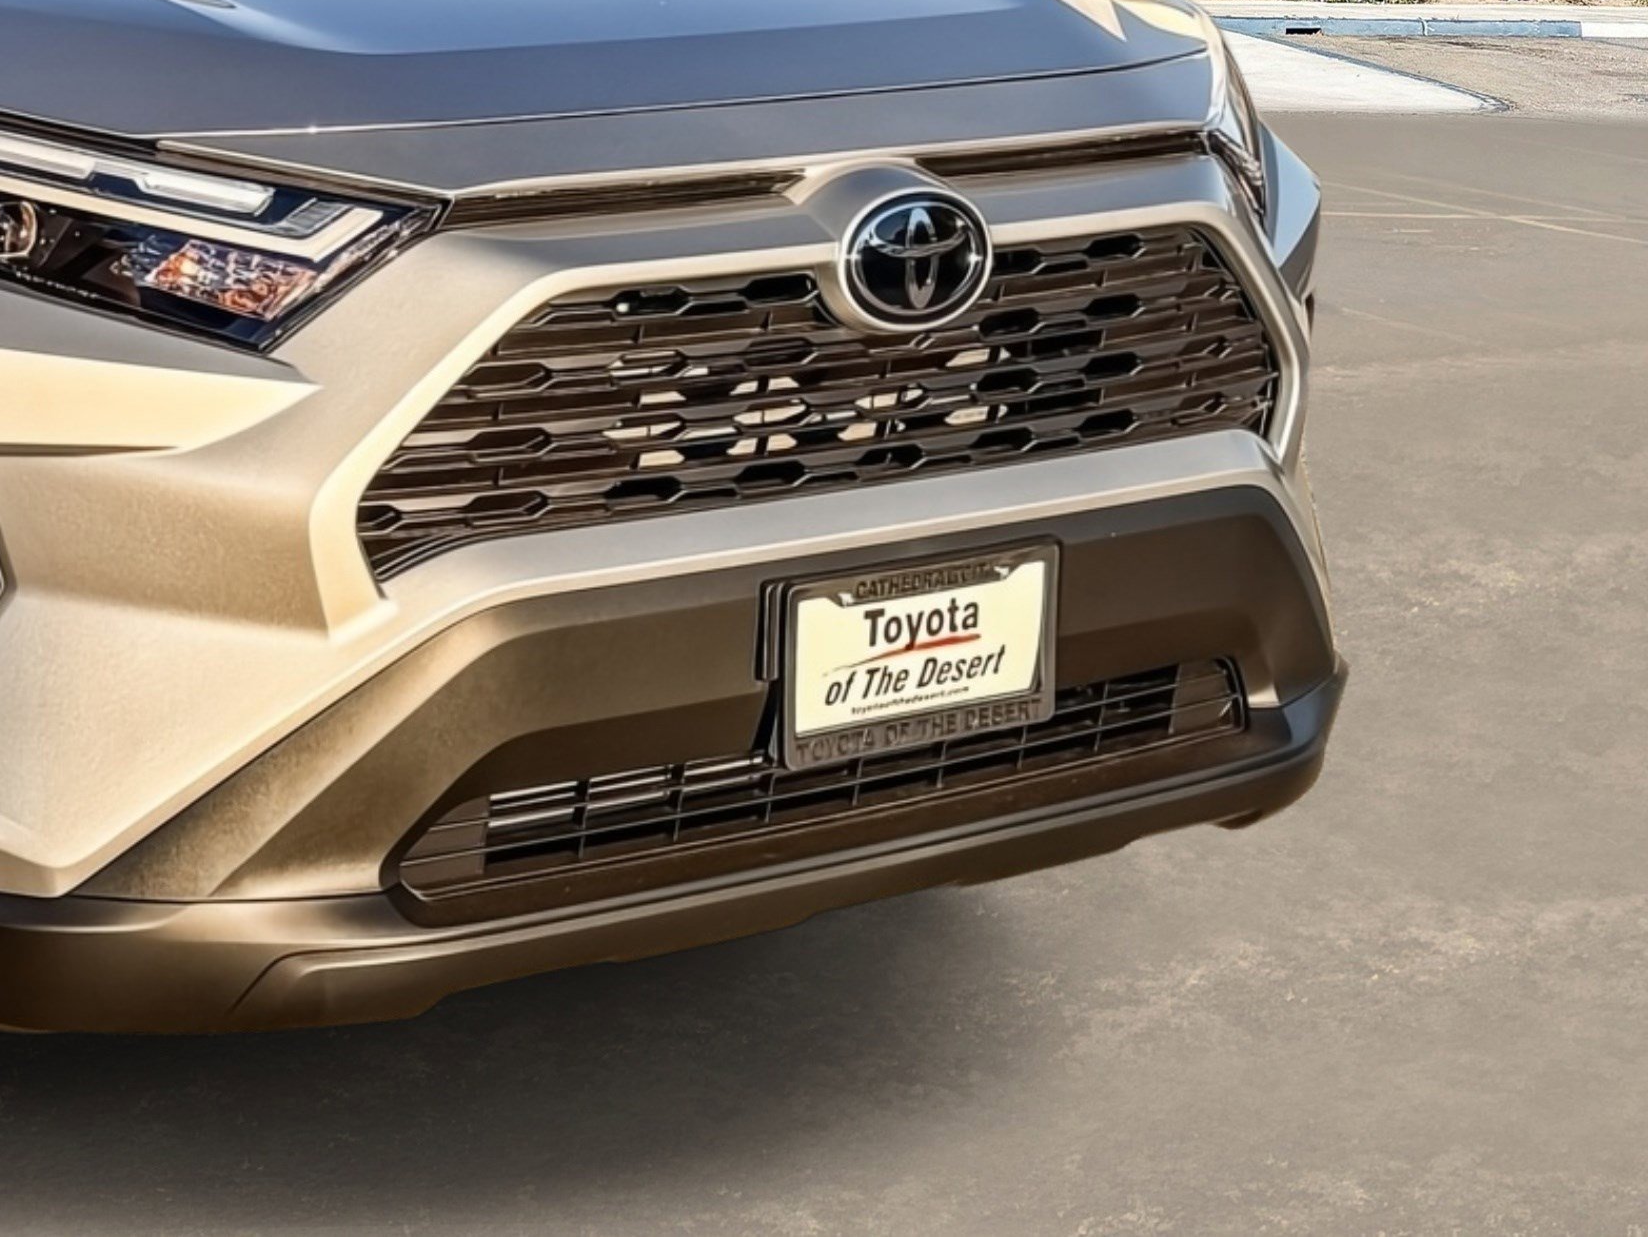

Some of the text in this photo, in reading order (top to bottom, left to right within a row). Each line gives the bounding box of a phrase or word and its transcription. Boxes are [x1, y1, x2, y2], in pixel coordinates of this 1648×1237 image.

[863, 598, 979, 650] Toyota
[825, 644, 1007, 706] of The Desert
[796, 699, 1042, 762] TOYOTA OF THE DESERT
